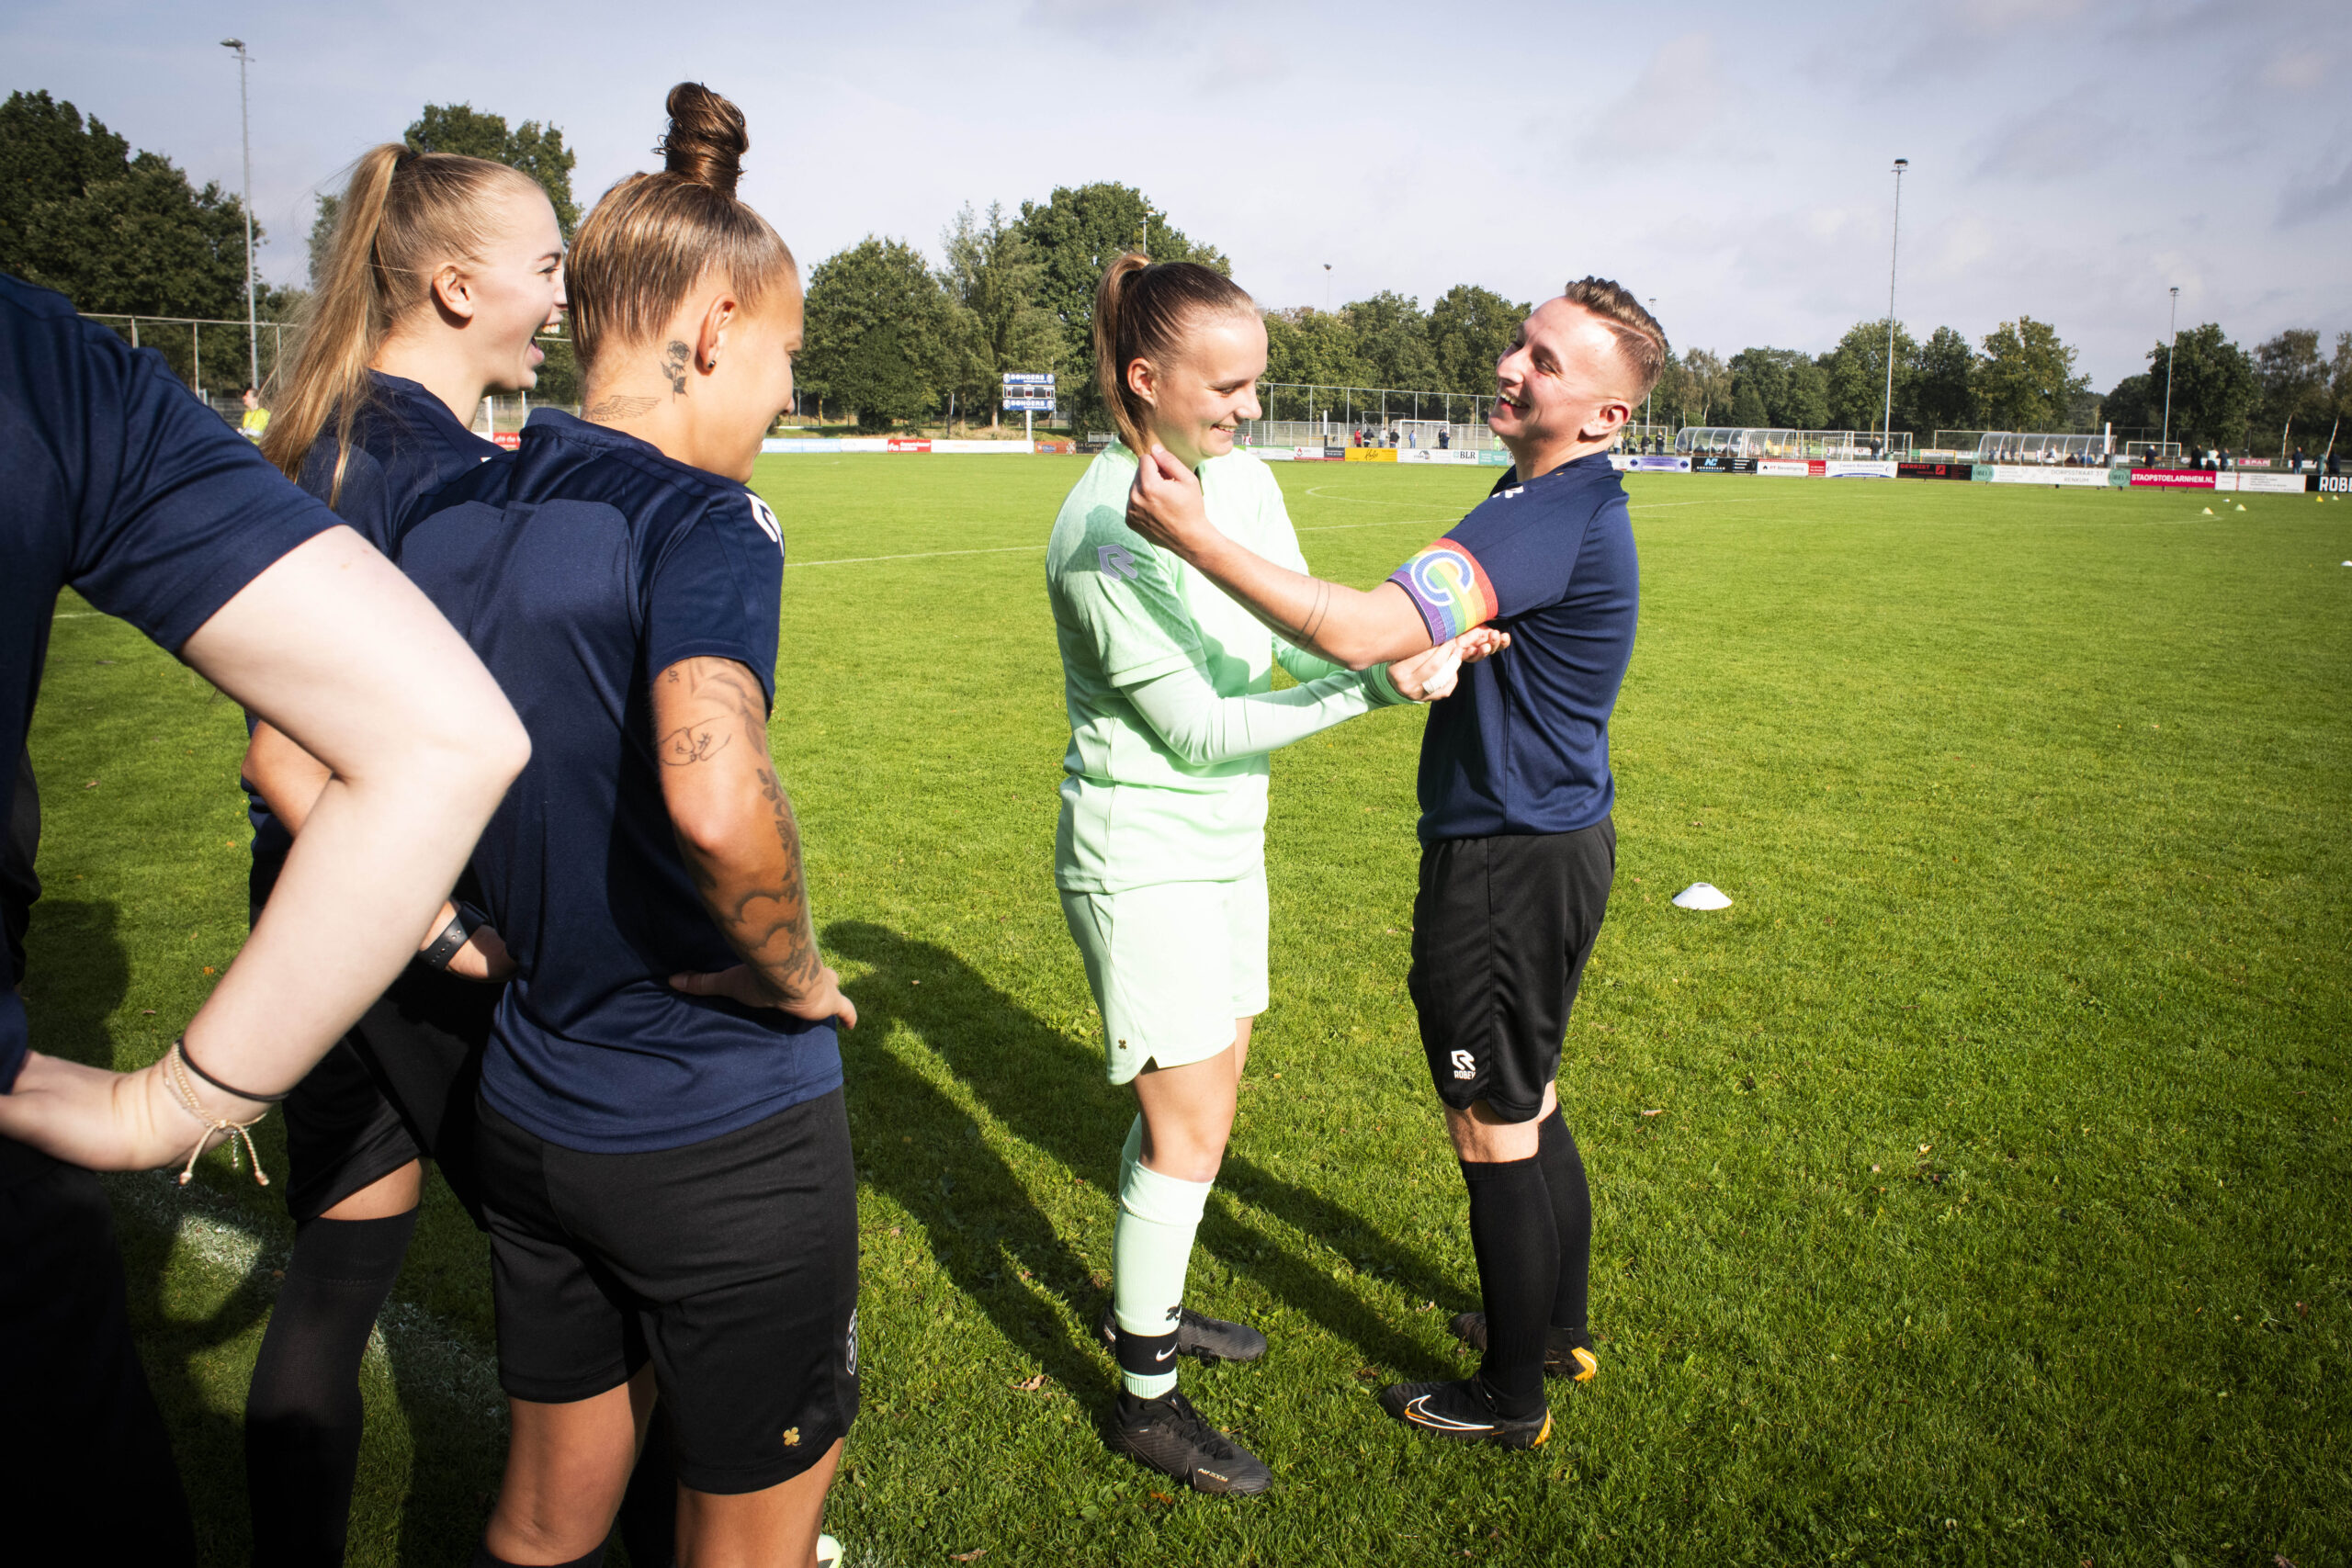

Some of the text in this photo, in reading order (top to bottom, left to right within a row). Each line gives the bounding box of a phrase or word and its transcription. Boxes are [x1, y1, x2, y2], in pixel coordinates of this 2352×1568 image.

[1460, 451, 1476, 459] BLR
[2132, 473, 2215, 483] STAOPSTOELARNHEM.NL
[1453, 1070, 1476, 1079] ROBEY
